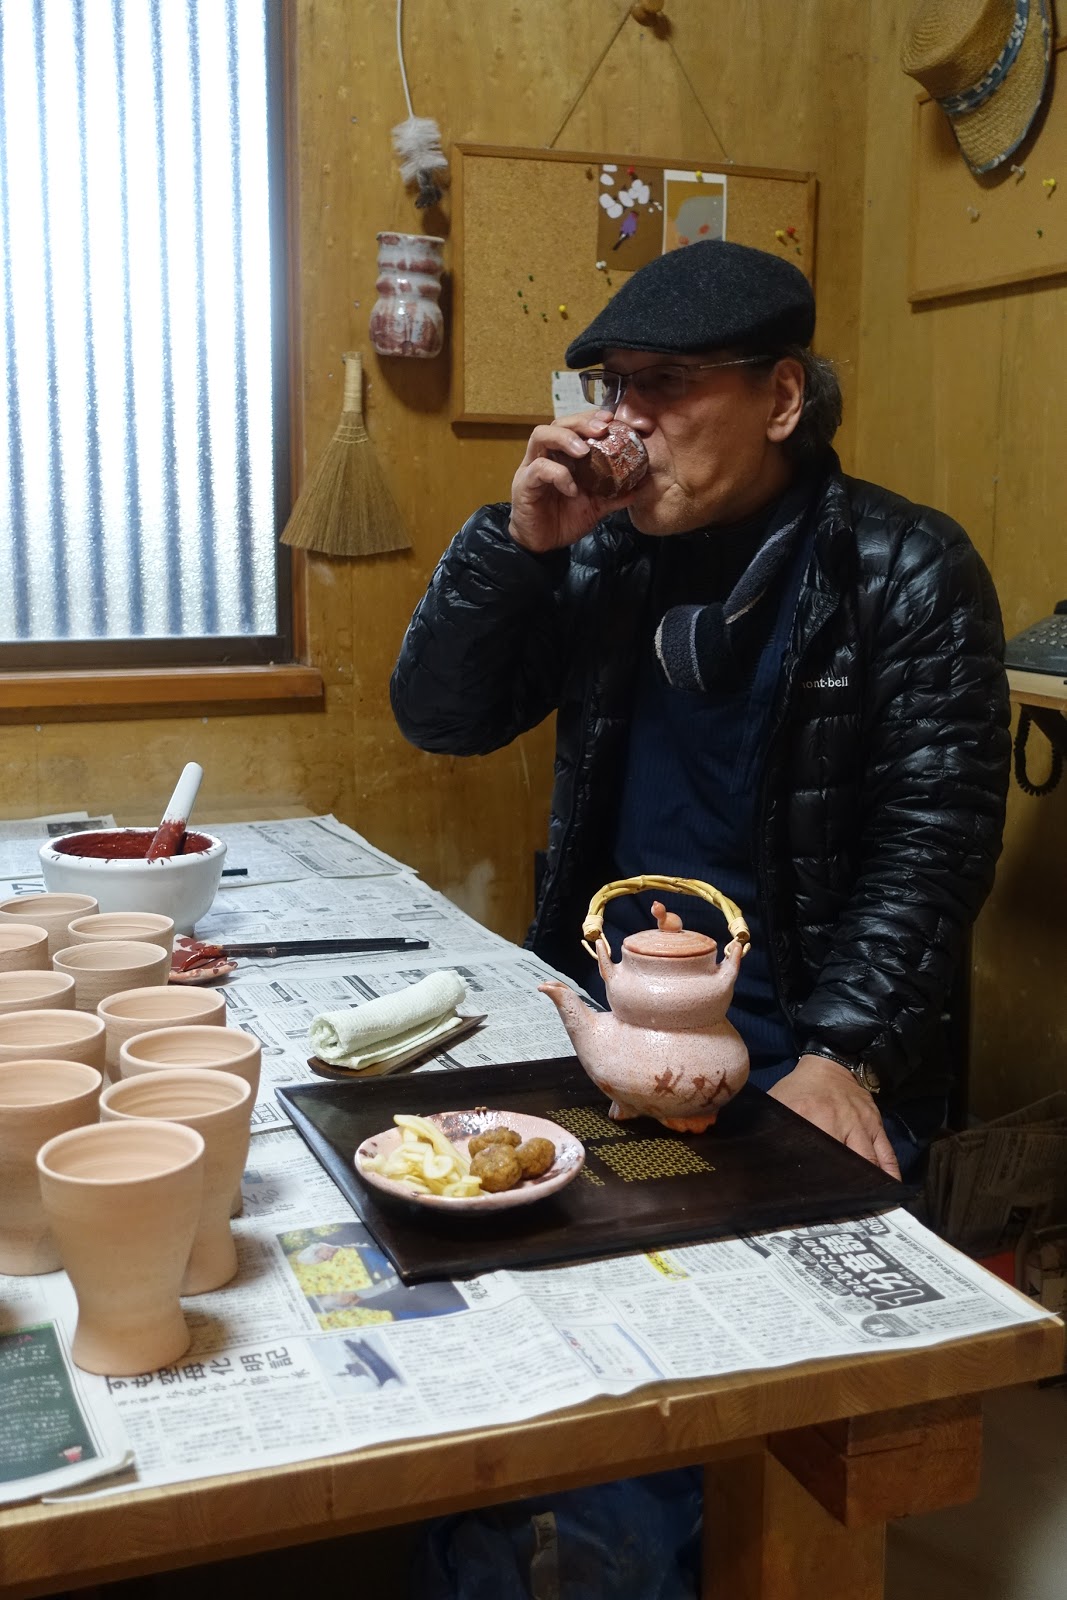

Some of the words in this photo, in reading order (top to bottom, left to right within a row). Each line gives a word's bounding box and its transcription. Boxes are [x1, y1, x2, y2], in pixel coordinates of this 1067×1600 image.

[802, 1239, 871, 1294] おとなのための
[819, 1234, 925, 1306] 1分音読
